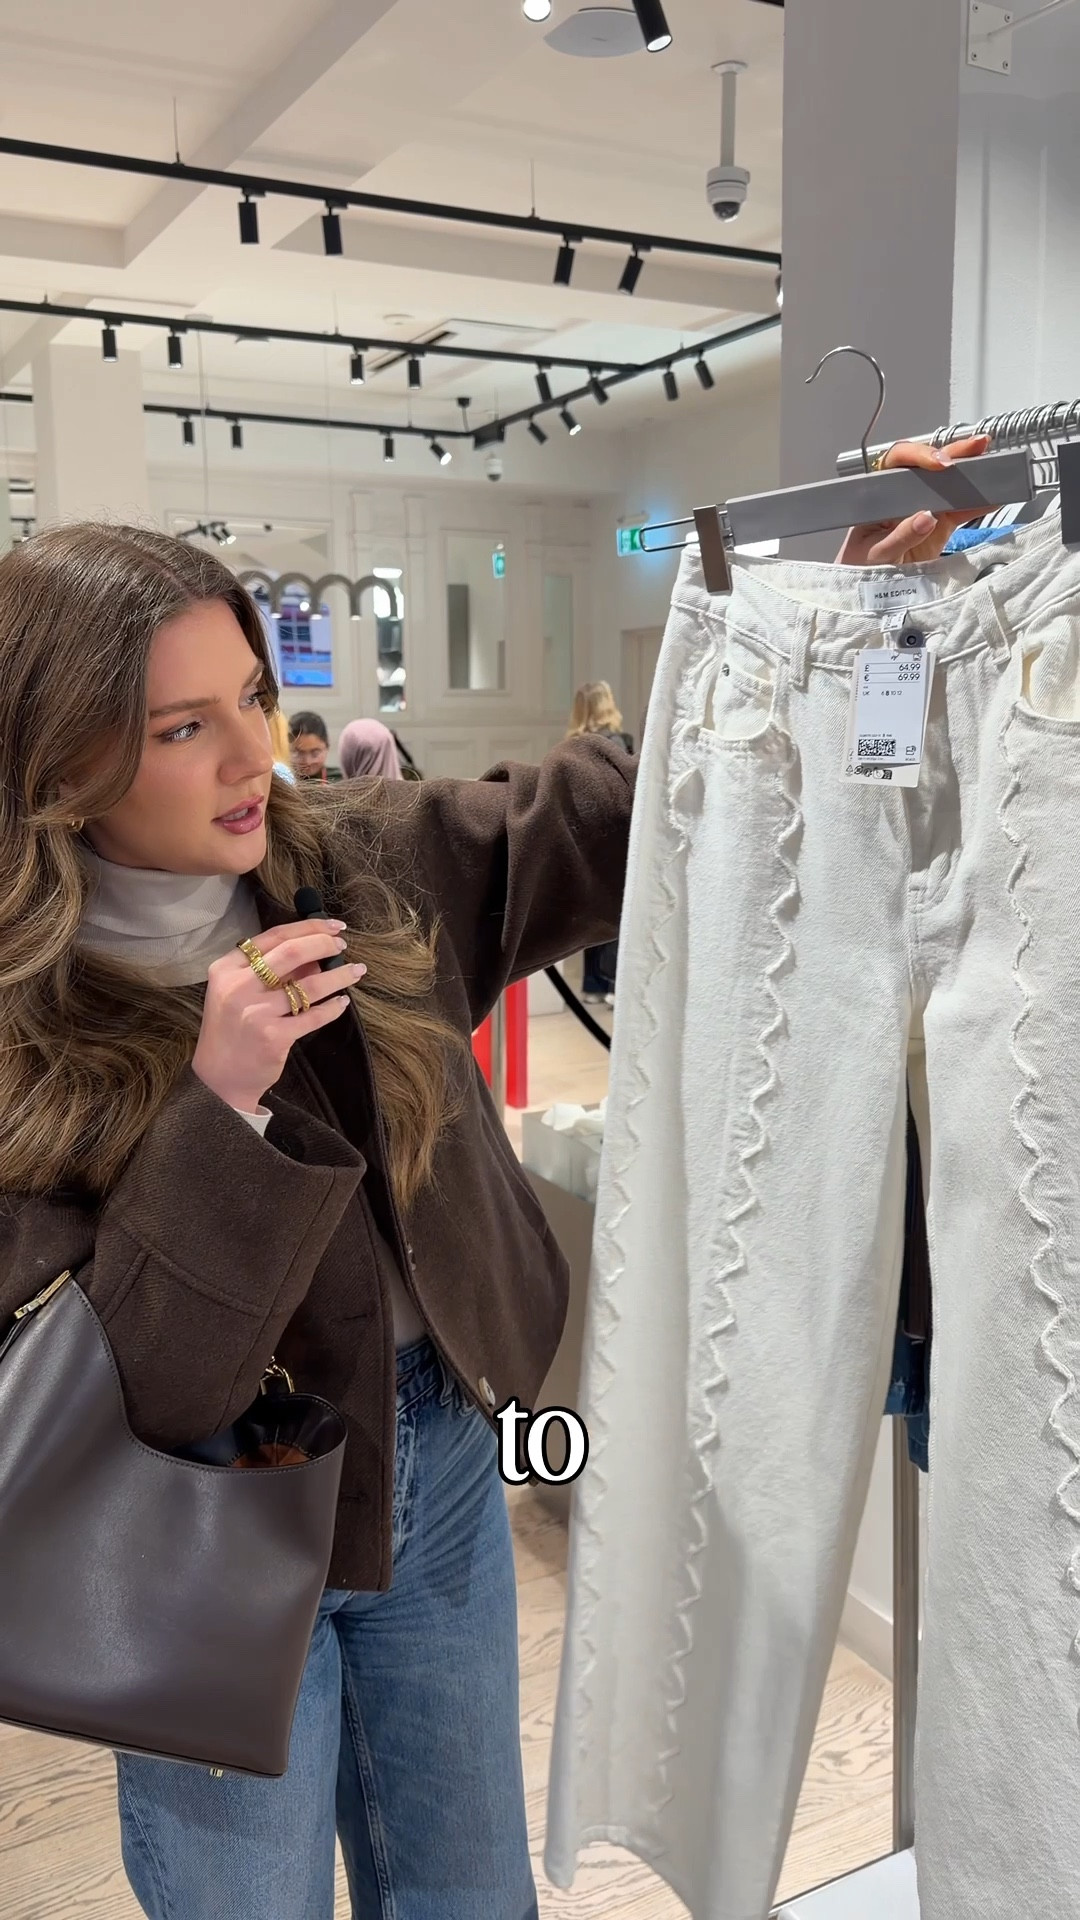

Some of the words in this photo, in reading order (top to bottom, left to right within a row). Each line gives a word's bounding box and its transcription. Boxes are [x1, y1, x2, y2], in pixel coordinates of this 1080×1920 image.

[874, 591, 889, 599] H&M
[890, 588, 917, 598] EDITION
[864, 664, 870, 672] £
[898, 663, 920, 671] 64.99
[897, 673, 920, 681] 69.99
